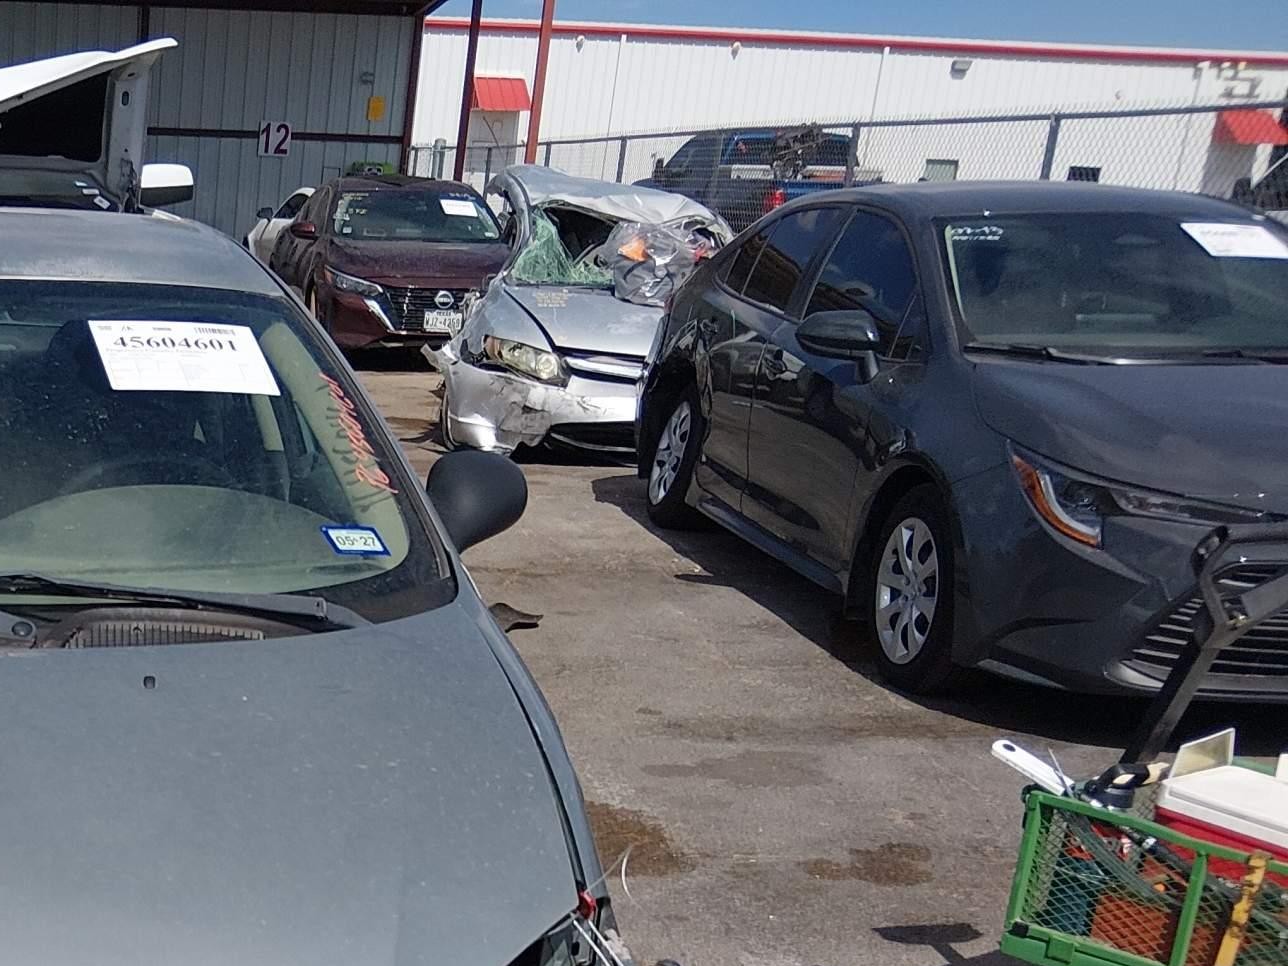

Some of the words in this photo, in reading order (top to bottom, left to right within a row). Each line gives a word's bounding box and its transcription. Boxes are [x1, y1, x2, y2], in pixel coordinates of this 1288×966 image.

[260, 122, 290, 155] 12
[113, 335, 238, 352] 45604601
[335, 535, 355, 546] 05
